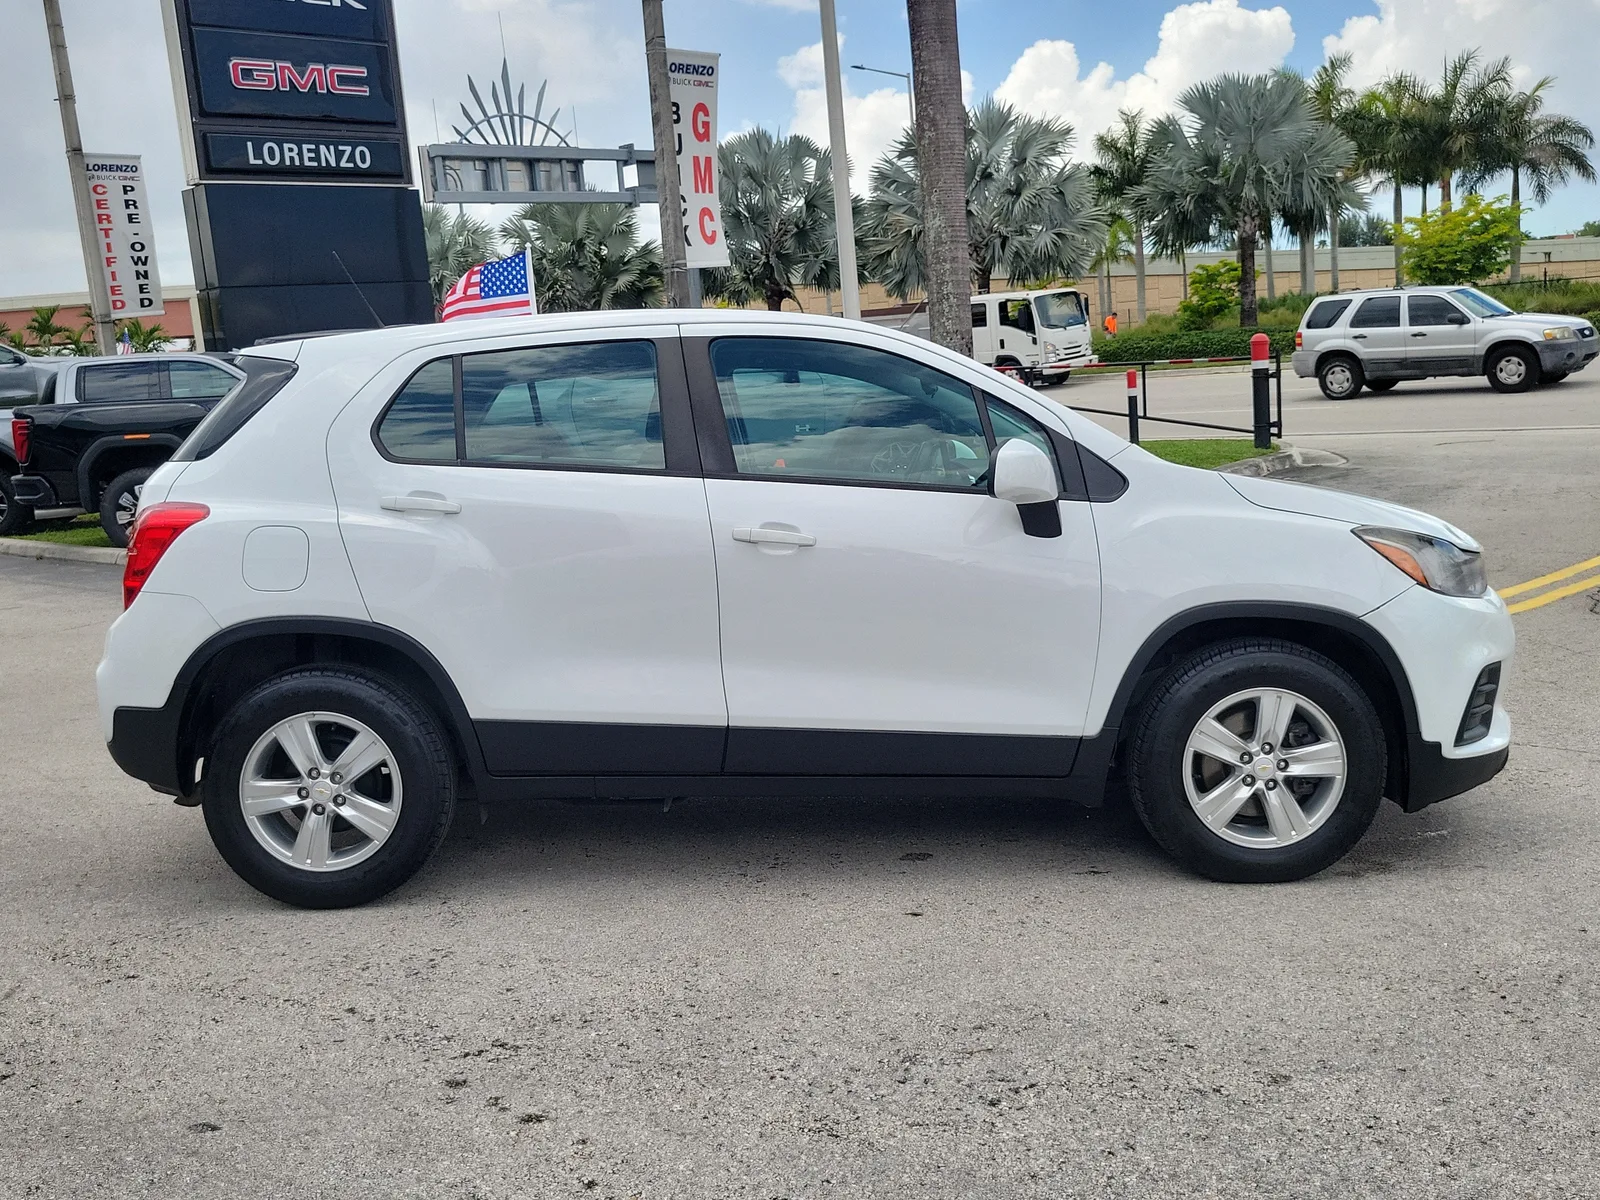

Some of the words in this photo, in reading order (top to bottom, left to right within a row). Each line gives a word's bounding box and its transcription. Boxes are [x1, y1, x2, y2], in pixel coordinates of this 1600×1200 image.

[229, 57, 369, 96] GMC
[669, 62, 715, 77] ORENZO
[672, 77, 692, 87] BUICK
[693, 79, 715, 88] GMC
[86, 163, 138, 173] LORENZO
[246, 141, 372, 169] LORENZO
[692, 102, 717, 246] GMC
[92, 184, 126, 311] CERTIFIED
[122, 184, 154, 308] PRE-OWNED
